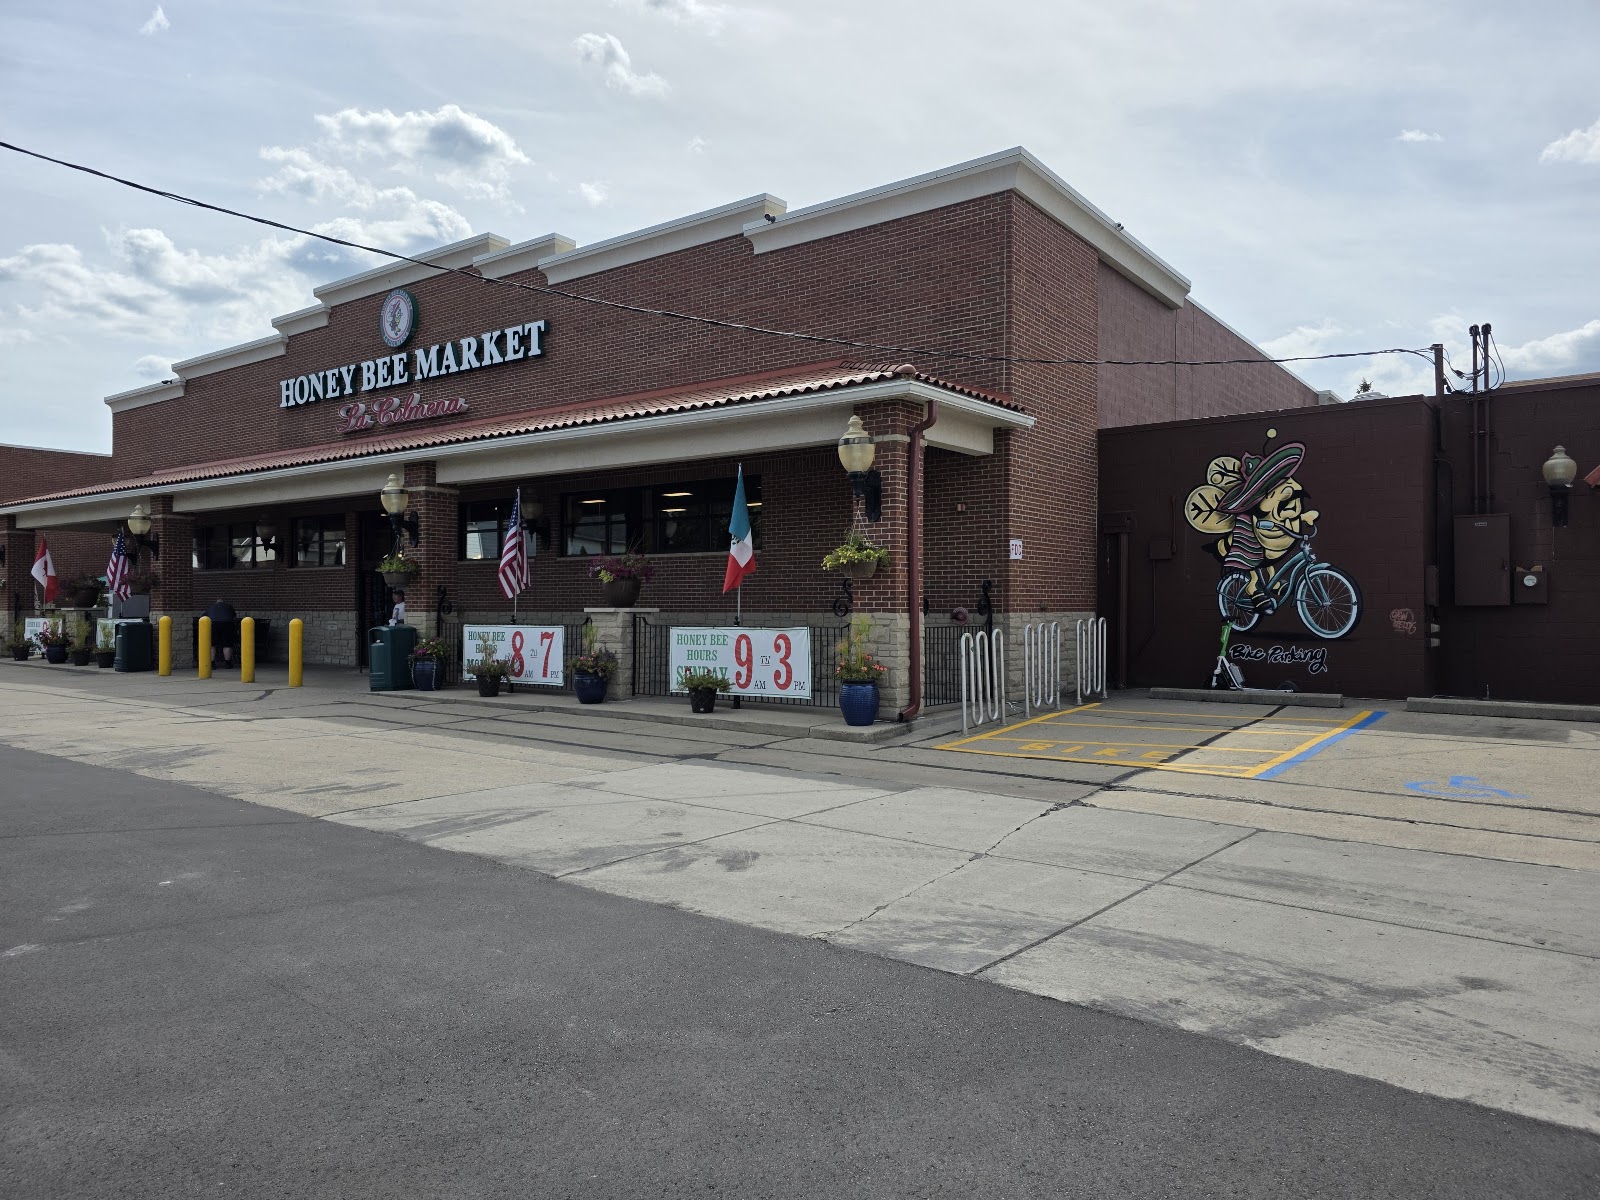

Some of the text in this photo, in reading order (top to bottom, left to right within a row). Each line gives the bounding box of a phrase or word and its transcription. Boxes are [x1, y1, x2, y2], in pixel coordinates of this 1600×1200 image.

[280, 320, 545, 408] HONEY BEE MARKET
[336, 392, 466, 432] La Colmena
[468, 631, 506, 642] HONEY BEE
[676, 633, 729, 646] HONEY BEE
[511, 630, 525, 678] 8
[524, 670, 534, 679] AM
[540, 631, 555, 678] 7
[686, 649, 718, 661] HOURS
[734, 633, 753, 690] 9
[754, 680, 766, 690] AM
[773, 633, 793, 691] 3
[793, 680, 806, 691] PM
[1229, 643, 1328, 675] Bike Parking
[676, 664, 729, 685] SNAY
[1018, 742, 1179, 760] BIKE
